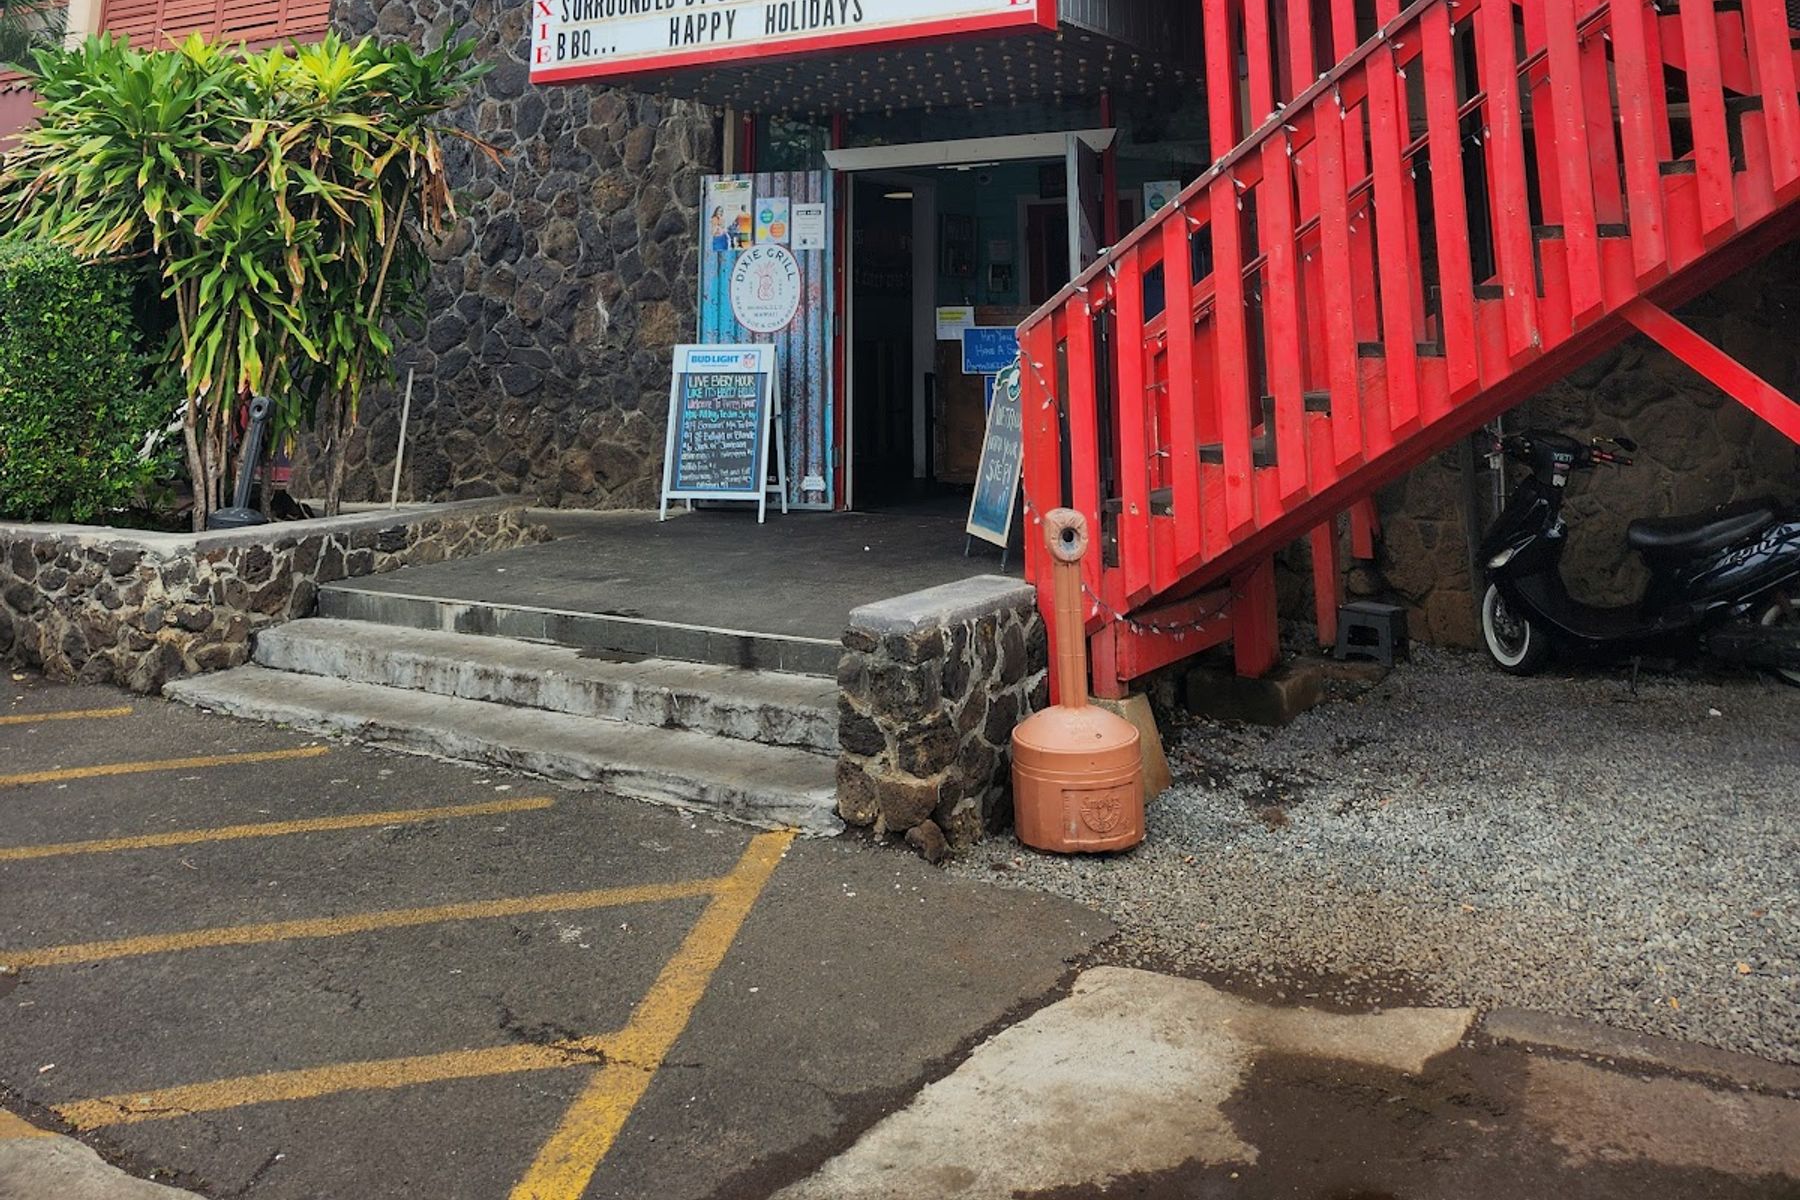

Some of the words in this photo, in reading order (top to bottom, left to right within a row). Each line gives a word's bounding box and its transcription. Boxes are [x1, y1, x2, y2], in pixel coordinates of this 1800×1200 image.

[669, 9, 737, 47] HAPPY
[735, 248, 762, 283] DIXIE
[766, 247, 796, 282] GRILL
[691, 355, 712, 364] BUD
[712, 355, 739, 364] LIGHT
[688, 375, 710, 388] LIVE
[711, 375, 734, 388] EVERY
[734, 374, 755, 387] HOUR
